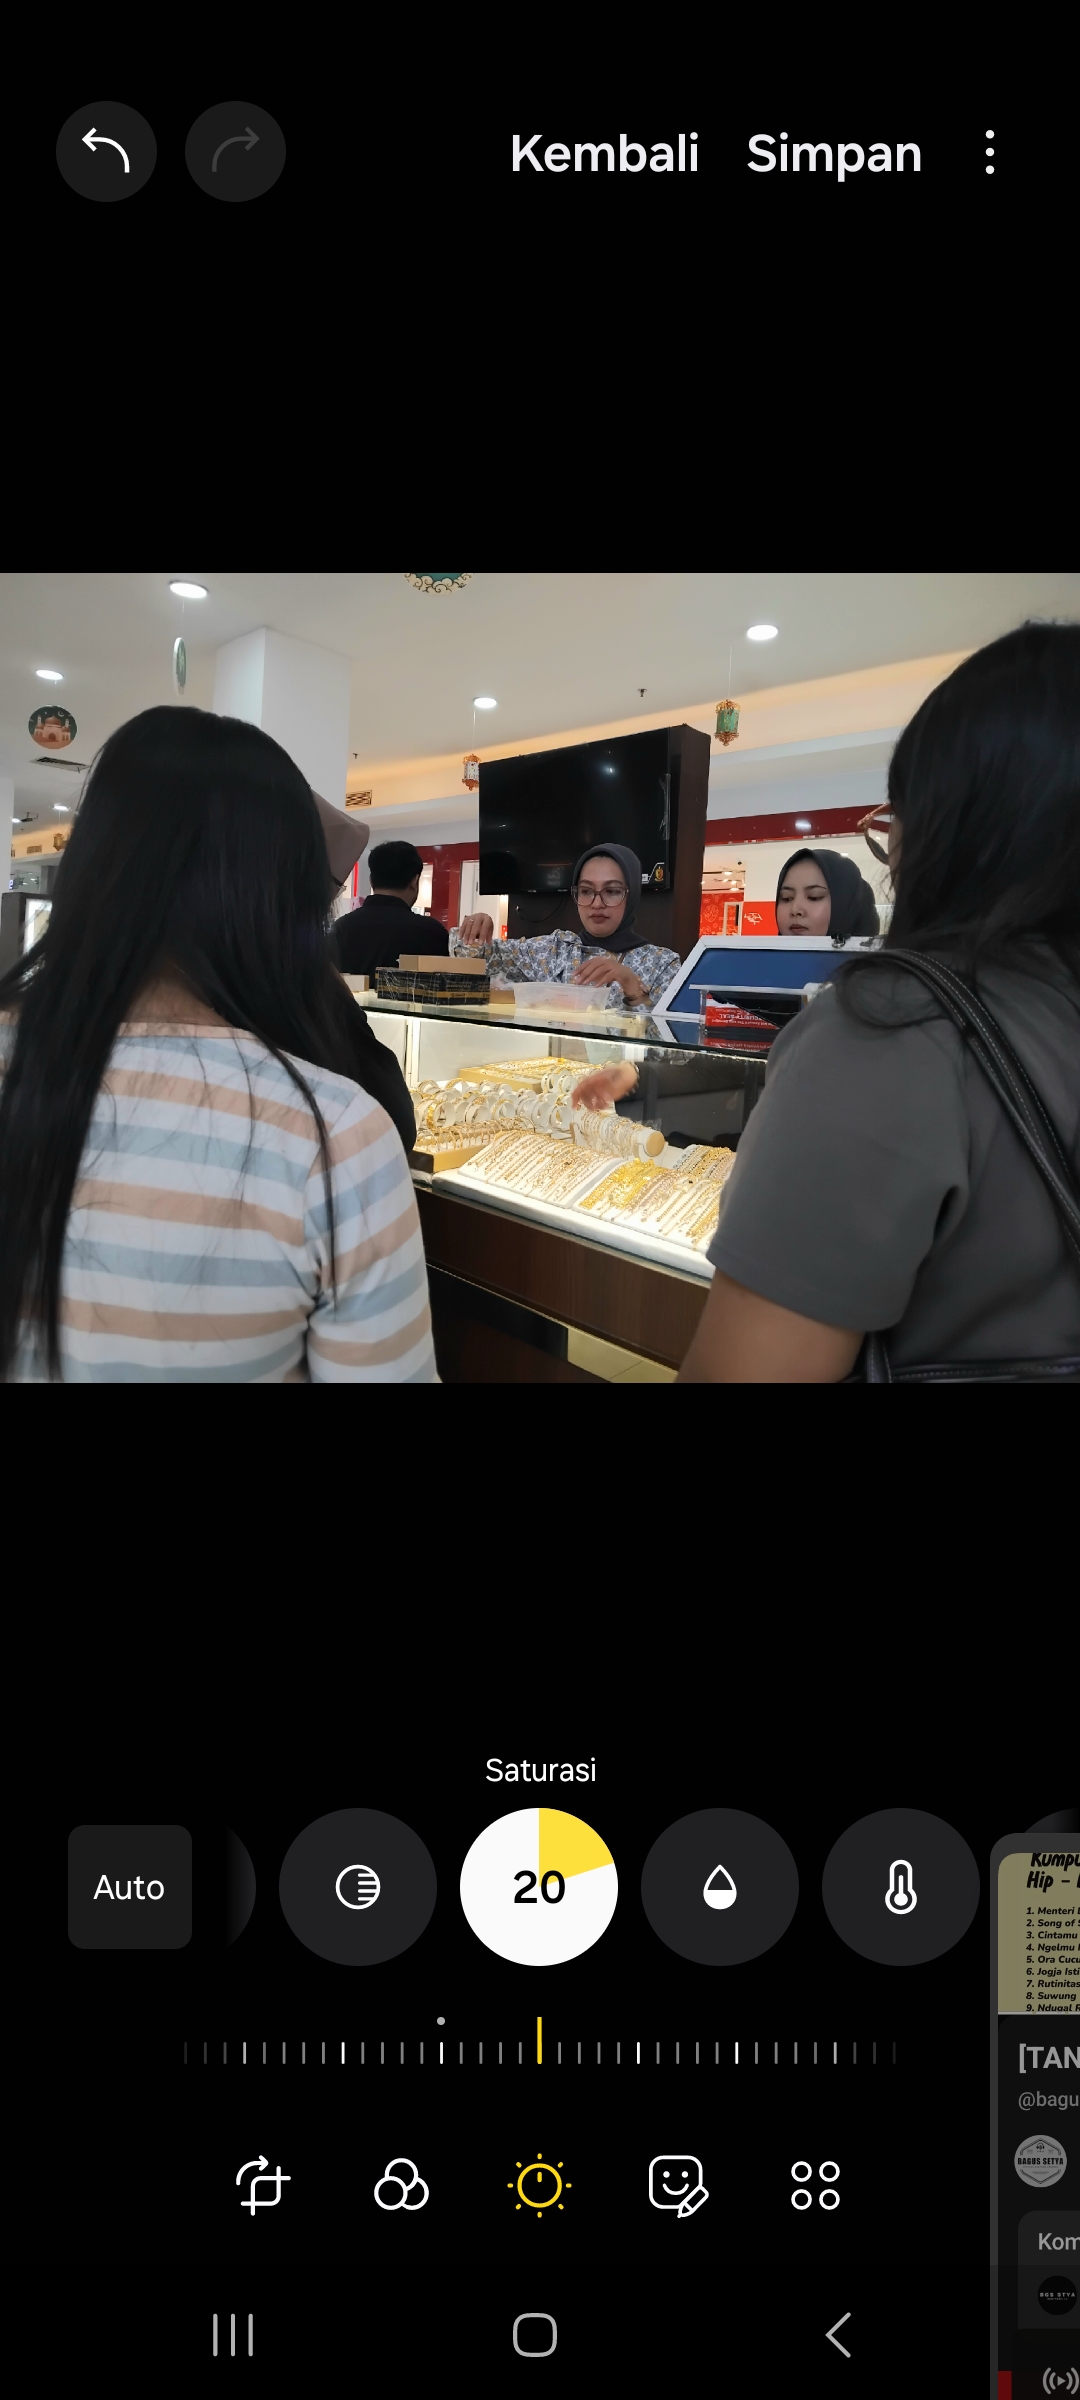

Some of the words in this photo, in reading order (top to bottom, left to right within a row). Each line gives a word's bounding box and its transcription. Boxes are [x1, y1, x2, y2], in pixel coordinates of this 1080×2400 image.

[512, 131, 700, 174] Kembali
[746, 131, 922, 183] Simpan
[485, 1756, 597, 1783] Saturasi
[92, 1874, 165, 1901] Auto
[513, 1869, 567, 1904] 20
[1026, 1871, 1054, 1894] Hip
[1026, 1906, 1035, 1915] 1.
[1037, 1906, 1075, 1915] Menteri
[1026, 1918, 1035, 1927] 2.
[1037, 1918, 1062, 1929] Song
[1064, 1918, 1076, 1927] of
[1026, 1930, 1035, 1939] 3.
[1037, 1930, 1078, 1939] Cintamu
[1026, 1943, 1035, 1952] 4.
[1037, 1943, 1075, 1953] Ngelmu
[1026, 1955, 1035, 1964] 5.
[1037, 1955, 1056, 1964] Ora
[1026, 1967, 1035, 1976] 6.
[1036, 1967, 1062, 1977] Jogja
[1026, 1979, 1035, 1988] 7.
[1037, 1979, 1080, 1988] Rutinitas
[1026, 1991, 1035, 2000] 8.
[1037, 1991, 1077, 2001] Suwung
[1026, 2003, 1035, 2012] 9.
[1019, 2042, 1080, 2074] [TAN
[1018, 2090, 1079, 2111] @bagu
[1017, 2157, 1041, 2165] BAGUS
[1042, 2157, 1064, 2165] SETYA
[1038, 2232, 1080, 2251] Kom
